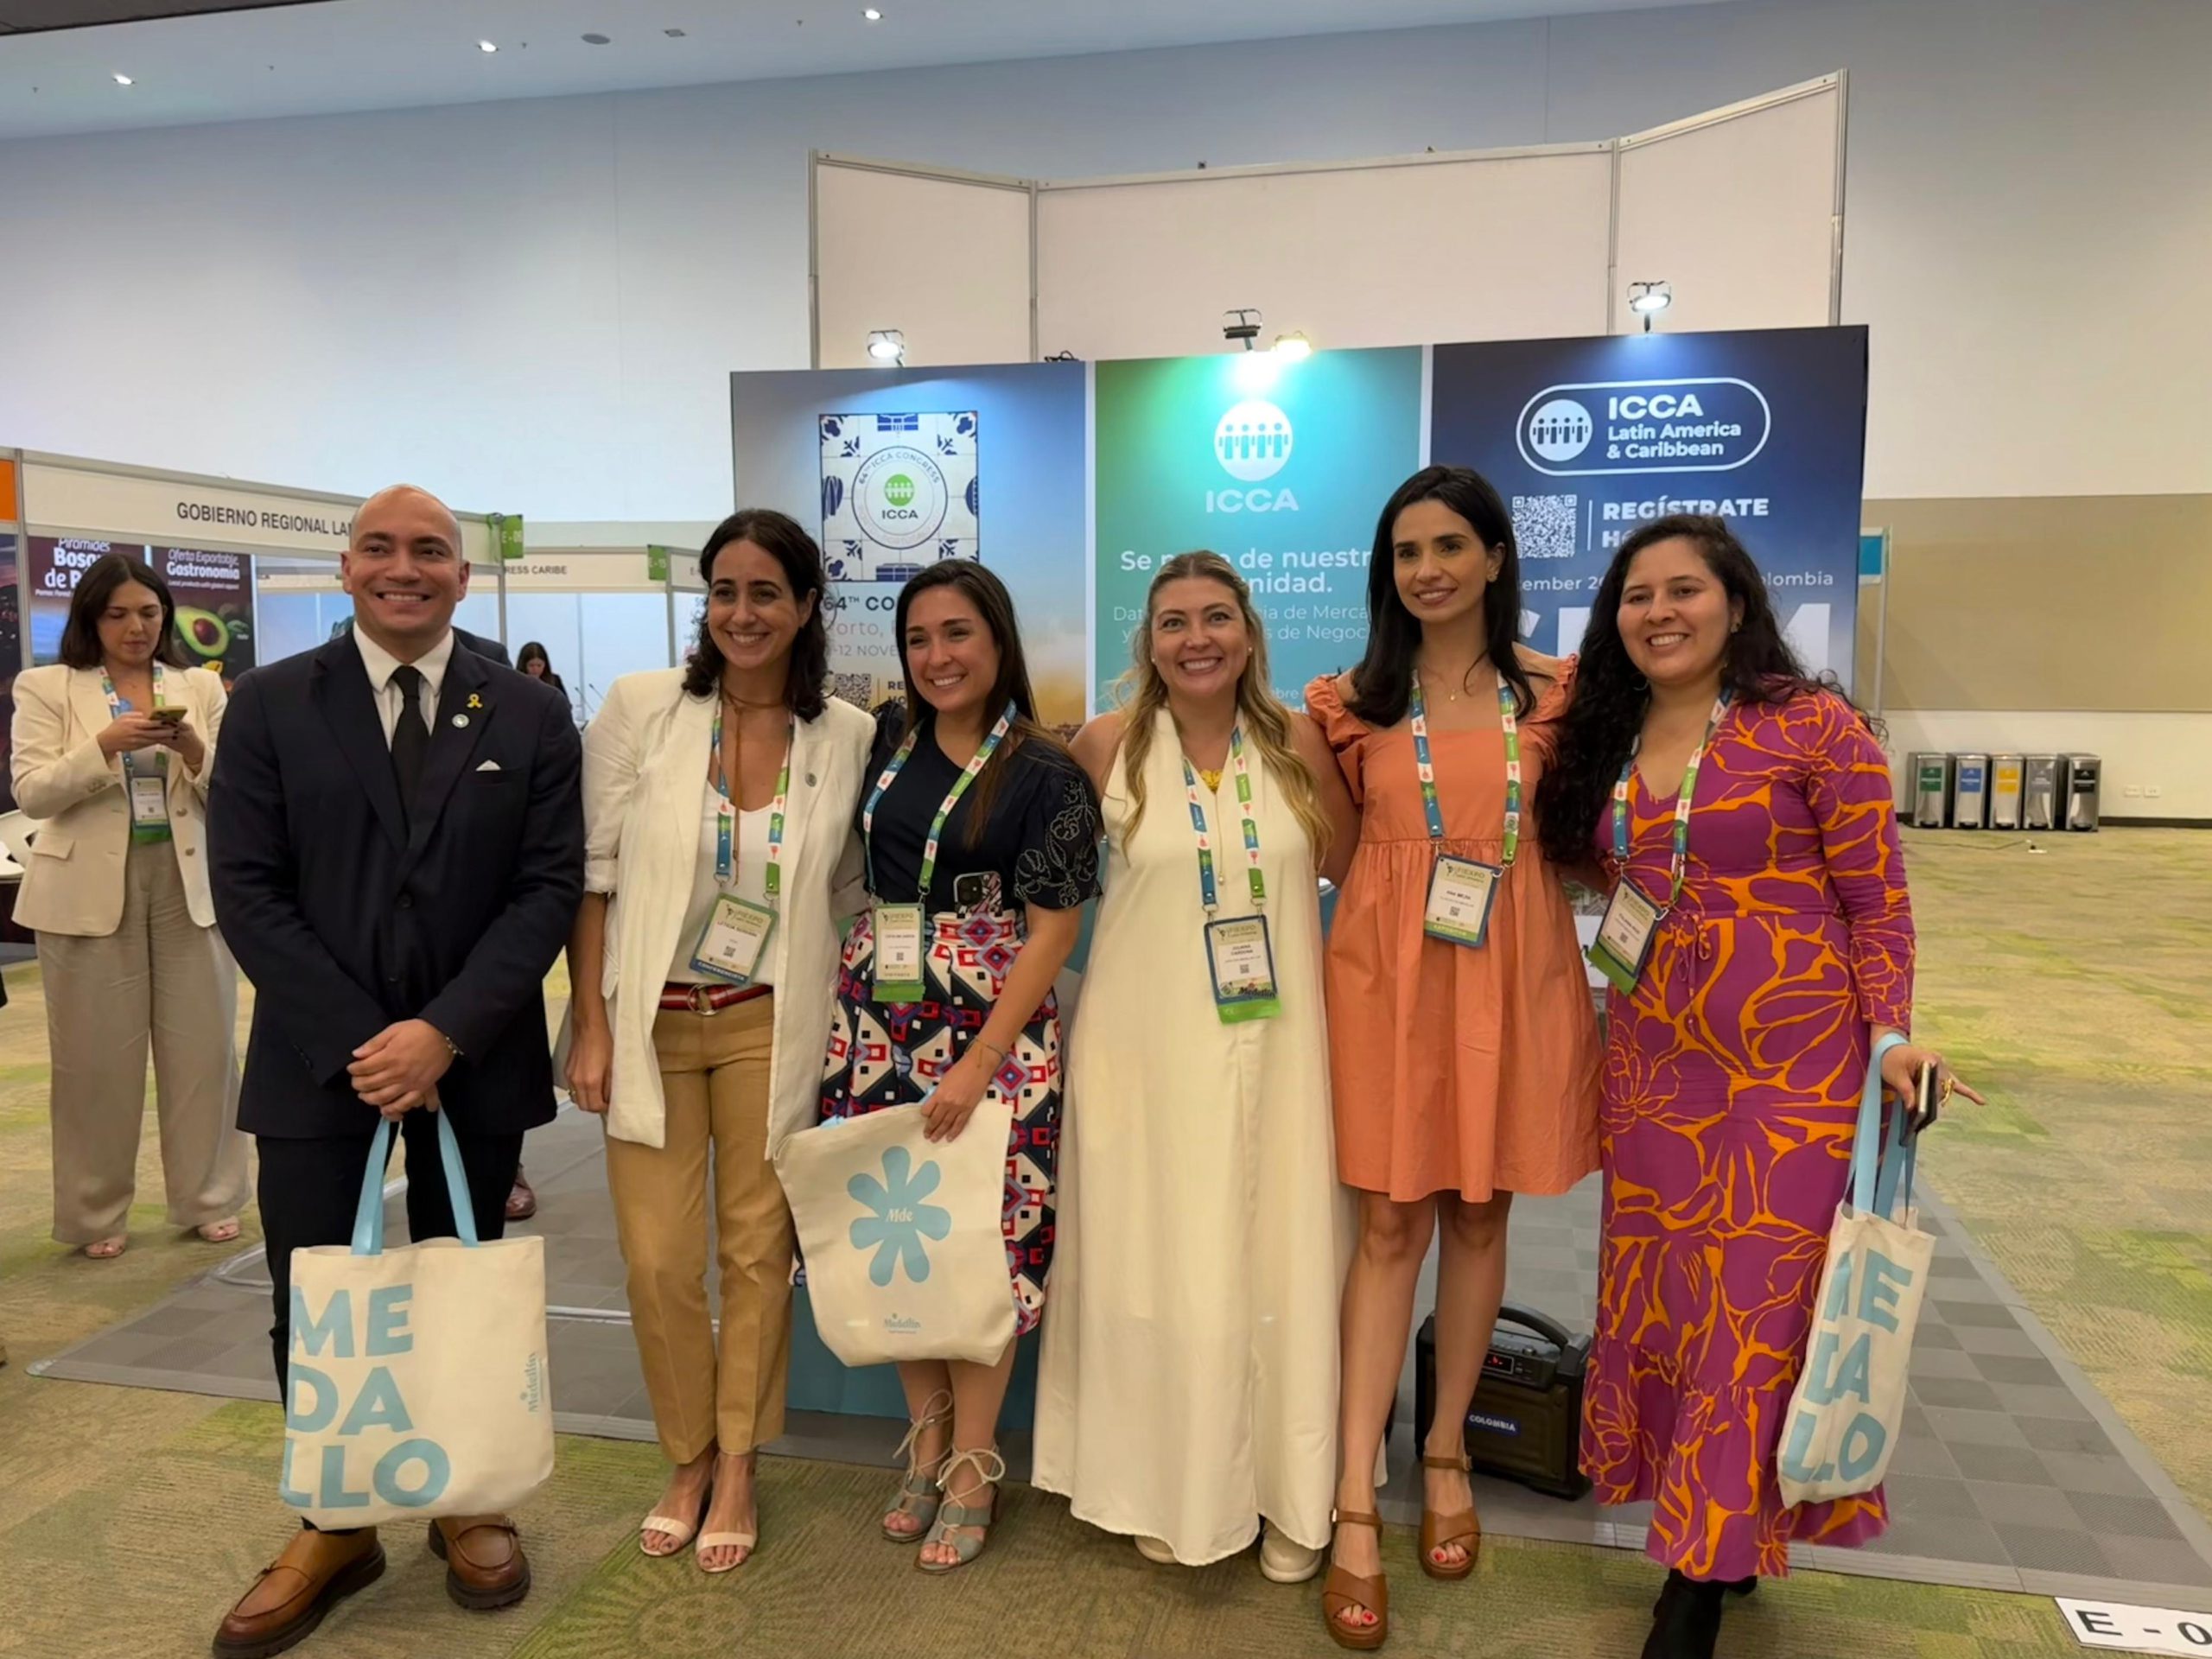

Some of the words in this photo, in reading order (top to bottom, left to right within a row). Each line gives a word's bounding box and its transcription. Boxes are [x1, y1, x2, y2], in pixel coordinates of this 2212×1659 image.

[1609, 393, 1704, 420] ICCA
[1608, 423, 1656, 441] Latin
[1660, 421, 1741, 439] America
[1606, 444, 1621, 459] &
[1624, 441, 1724, 458] Caribbean
[871, 453, 893, 467] ICCA
[895, 451, 941, 483] CONGRESS
[1205, 488, 1299, 512] ICCA
[1603, 495, 1769, 520] REGÍSTRATE
[177, 502, 257, 526] GOBIERNO
[261, 512, 329, 534] REGIONAL
[881, 509, 918, 519] ICCA
[54, 547, 102, 569] Bosq
[168, 548, 195, 563] Oferta
[1120, 550, 1151, 570] Se
[1239, 548, 1273, 569] de
[1282, 548, 1371, 568] nuestr
[44, 568, 67, 588] de
[505, 565, 530, 575] RESS
[531, 565, 568, 575] CARIBE
[1249, 571, 1332, 593] nidad.
[1522, 577, 1582, 591] ember
[1762, 570, 1834, 587] lombia
[866, 596, 895, 611] CO
[1113, 607, 1142, 621] Dat
[1284, 606, 1306, 620] de
[1313, 606, 1368, 620] Merca
[836, 621, 883, 638] orto,
[1277, 626, 1300, 639] de
[1306, 625, 1367, 642] Negoc
[833, 645, 851, 657] -12
[857, 645, 899, 657] NOVE
[888, 681, 905, 690] RE
[289, 1284, 414, 1358] ME
[286, 1361, 414, 1435] DA
[1469, 1414, 1516, 1432] COLOMBIA
[280, 1438, 450, 1509] LLO
